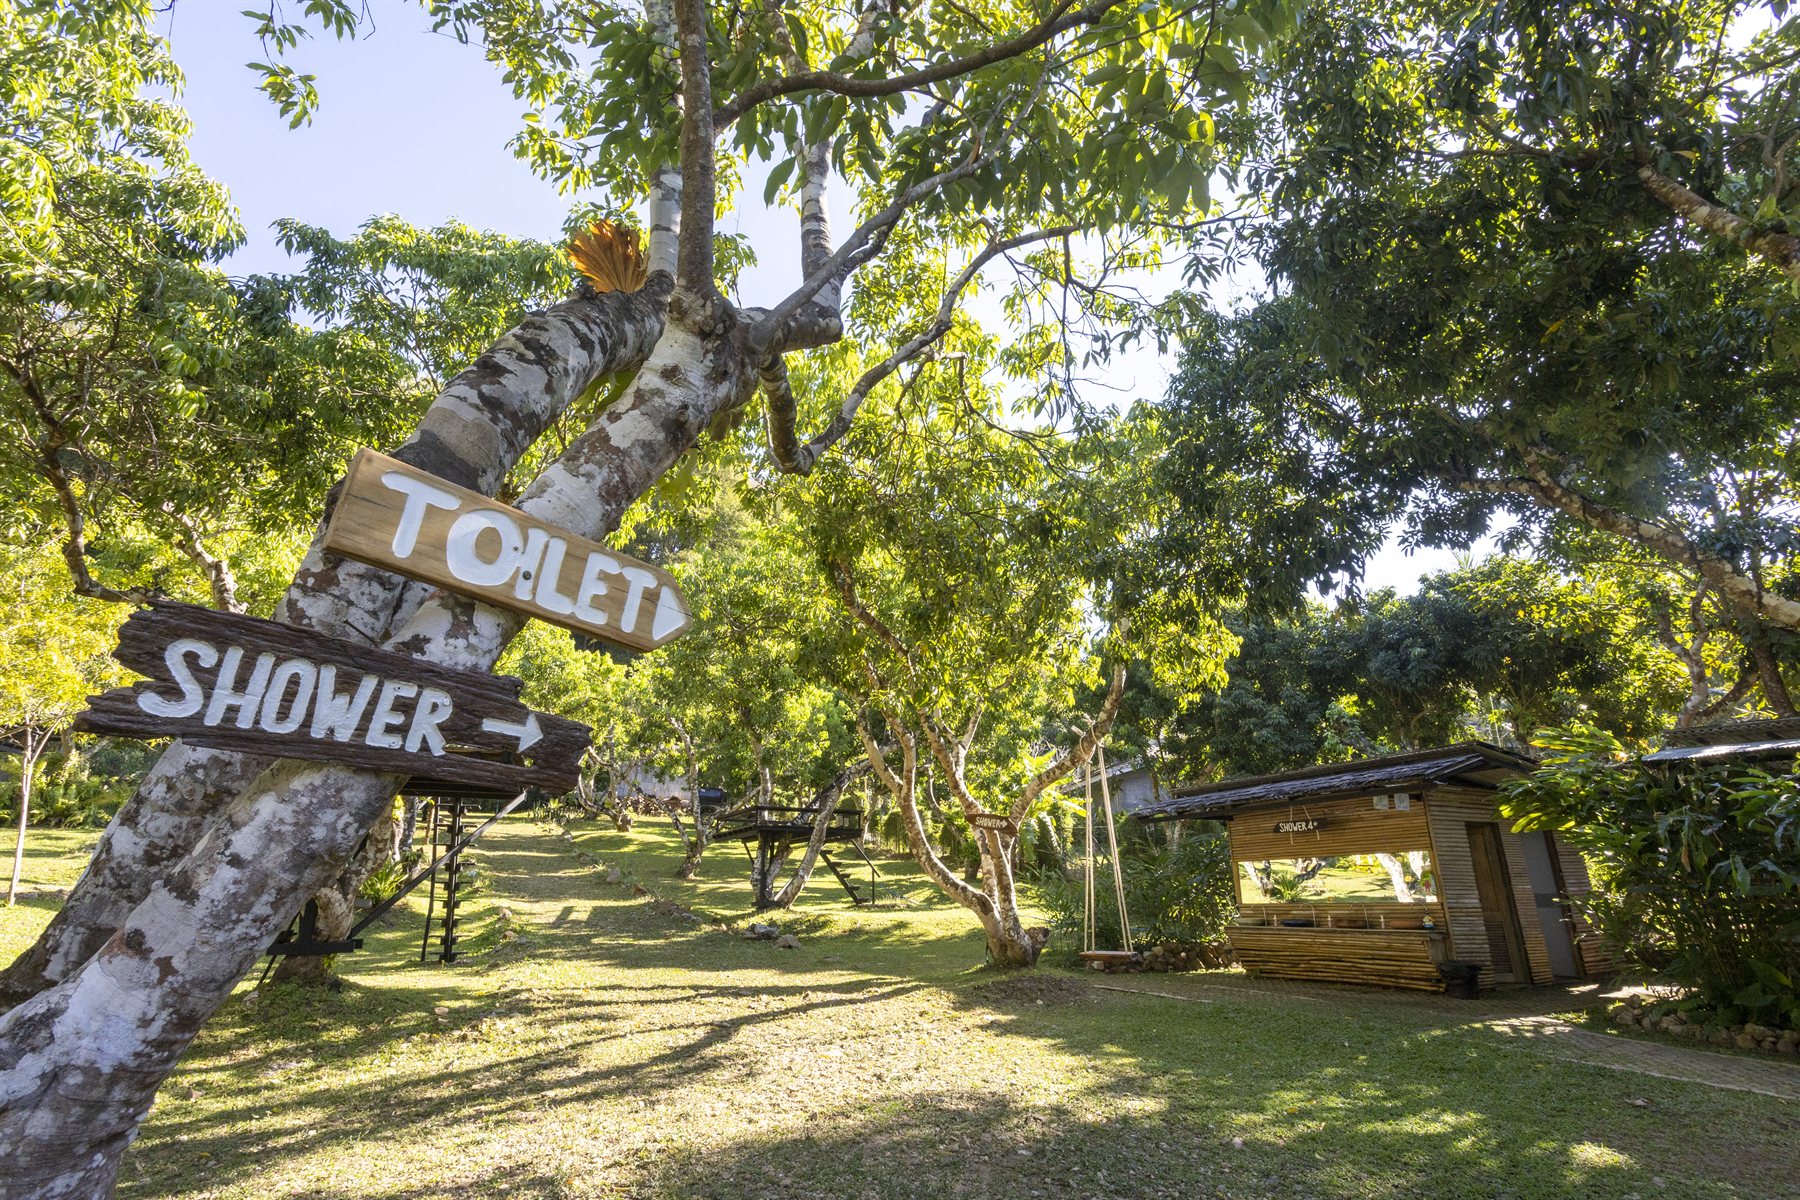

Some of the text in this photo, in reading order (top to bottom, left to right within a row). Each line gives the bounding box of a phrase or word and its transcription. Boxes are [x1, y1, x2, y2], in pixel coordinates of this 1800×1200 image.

[381, 469, 659, 634] TOILET
[136, 638, 453, 757] SHOWER
[975, 816, 1001, 828] SHOWER
[1279, 821, 1307, 832] SHOWER
